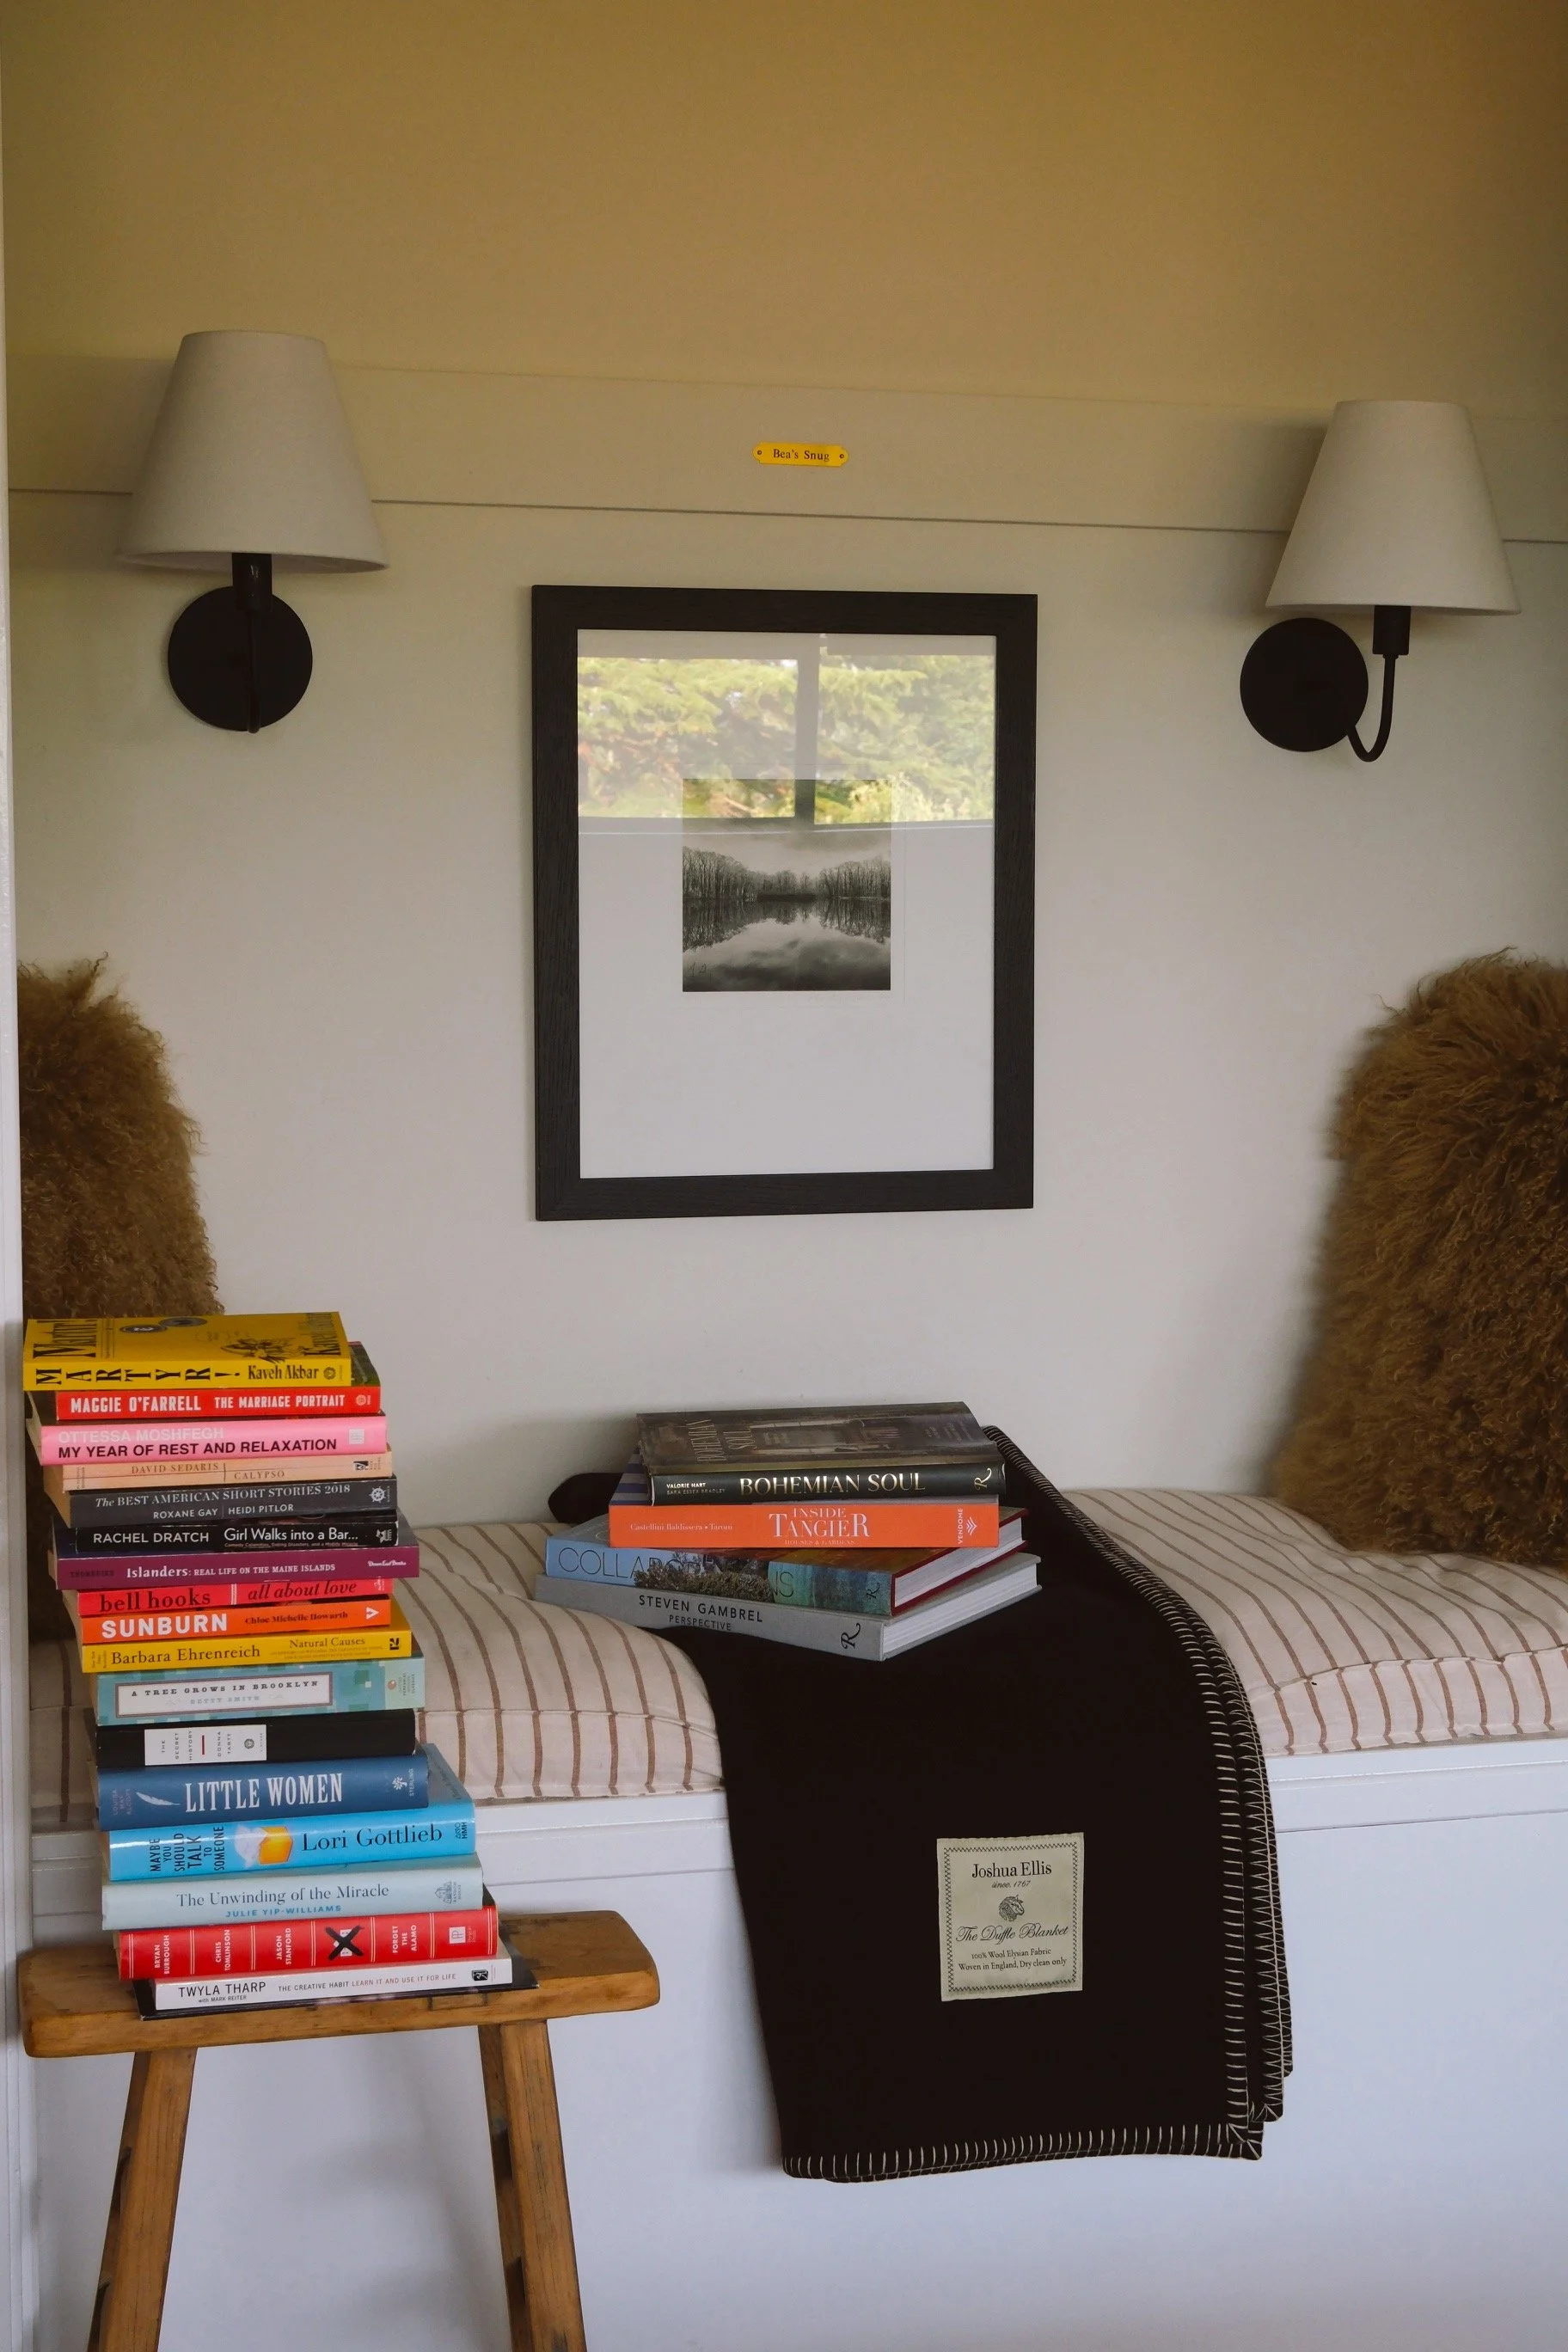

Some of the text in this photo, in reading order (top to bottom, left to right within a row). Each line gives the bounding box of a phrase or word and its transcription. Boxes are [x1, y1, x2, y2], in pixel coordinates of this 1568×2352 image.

[773, 448, 830, 462] Bea's Snug
[36, 1367, 240, 1385] MARTYR!
[248, 1364, 319, 1380] Kaveh Akbar
[70, 1396, 202, 1413] MAGGIE O'FARRELL
[214, 1394, 345, 1409] THE MARRIAGE PORTRAIT
[58, 1427, 224, 1444] OTTESSA MOSHFEGH
[58, 1439, 337, 1459] MY YEAR OF REST AND RELAXATION
[132, 1462, 219, 1474] DAVID SEDARIS
[234, 1471, 285, 1480] CALYPSO
[739, 1473, 926, 1496] BOHEMIAN SOUL
[95, 1484, 351, 1508] The BEST AMERICAN SHORT STORIES 2018
[153, 1508, 218, 1520] ROXANE GAY
[228, 1504, 294, 1516] HEIDI PITLOR
[793, 1508, 846, 1518] INSIDE
[224, 1527, 358, 1541] Girl Walks into a Bar...
[769, 1513, 870, 1538] TANGIER
[93, 1532, 209, 1544] RACHEL DRATCH
[126, 1565, 192, 1579] Islanders:
[193, 1568, 216, 1577] REAL
[218, 1567, 237, 1576] LIFE
[253, 1565, 270, 1574] THE
[273, 1565, 298, 1574] MAINE
[301, 1564, 336, 1572] ISLANDS
[248, 1583, 271, 1601] all
[273, 1580, 319, 1598] about
[324, 1580, 358, 1596] love
[100, 1588, 211, 1613] bell hooks
[639, 1595, 763, 1623] STEVEN GAMBREL
[101, 1613, 228, 1638] SUNBURN
[669, 1614, 732, 1632] PERSPECTIVE
[289, 1637, 366, 1649] Natural Causes
[111, 1650, 172, 1665] Barbara
[176, 1645, 260, 1662] Ehrenreich
[144, 1688, 177, 1697] TREE
[184, 1685, 226, 1694] GROWS
[253, 1681, 318, 1690] BROOKLYN
[185, 1773, 343, 1813] LITTLE WOMEN
[301, 1823, 443, 1852] Lori Gottlieb
[150, 1838, 162, 1872] MAYBE
[162, 1846, 172, 1862] YOU
[175, 1833, 185, 1872] SHOULD
[187, 1835, 202, 1870] TALK
[203, 1846, 212, 1858] TO
[213, 1826, 224, 1871] SOMEONE
[971, 1859, 1052, 1878] Joshua Ellis
[176, 1883, 389, 1908] The Unwinding of the Miracle
[225, 1905, 343, 1918] JULIE YIP-WILLIAMS
[955, 1922, 1069, 1945] The Duffle Blanket
[989, 1951, 1006, 1959] Wool
[1007, 1949, 1030, 1959] Elysian
[959, 1963, 982, 1971] Woven
[1020, 1959, 1032, 1969] Dry
[1032, 1958, 1050, 1967] clean
[1051, 1957, 1068, 1967] only
[178, 1981, 266, 1999] TWYLA THARP
[294, 1981, 327, 1991] CREATIVE
